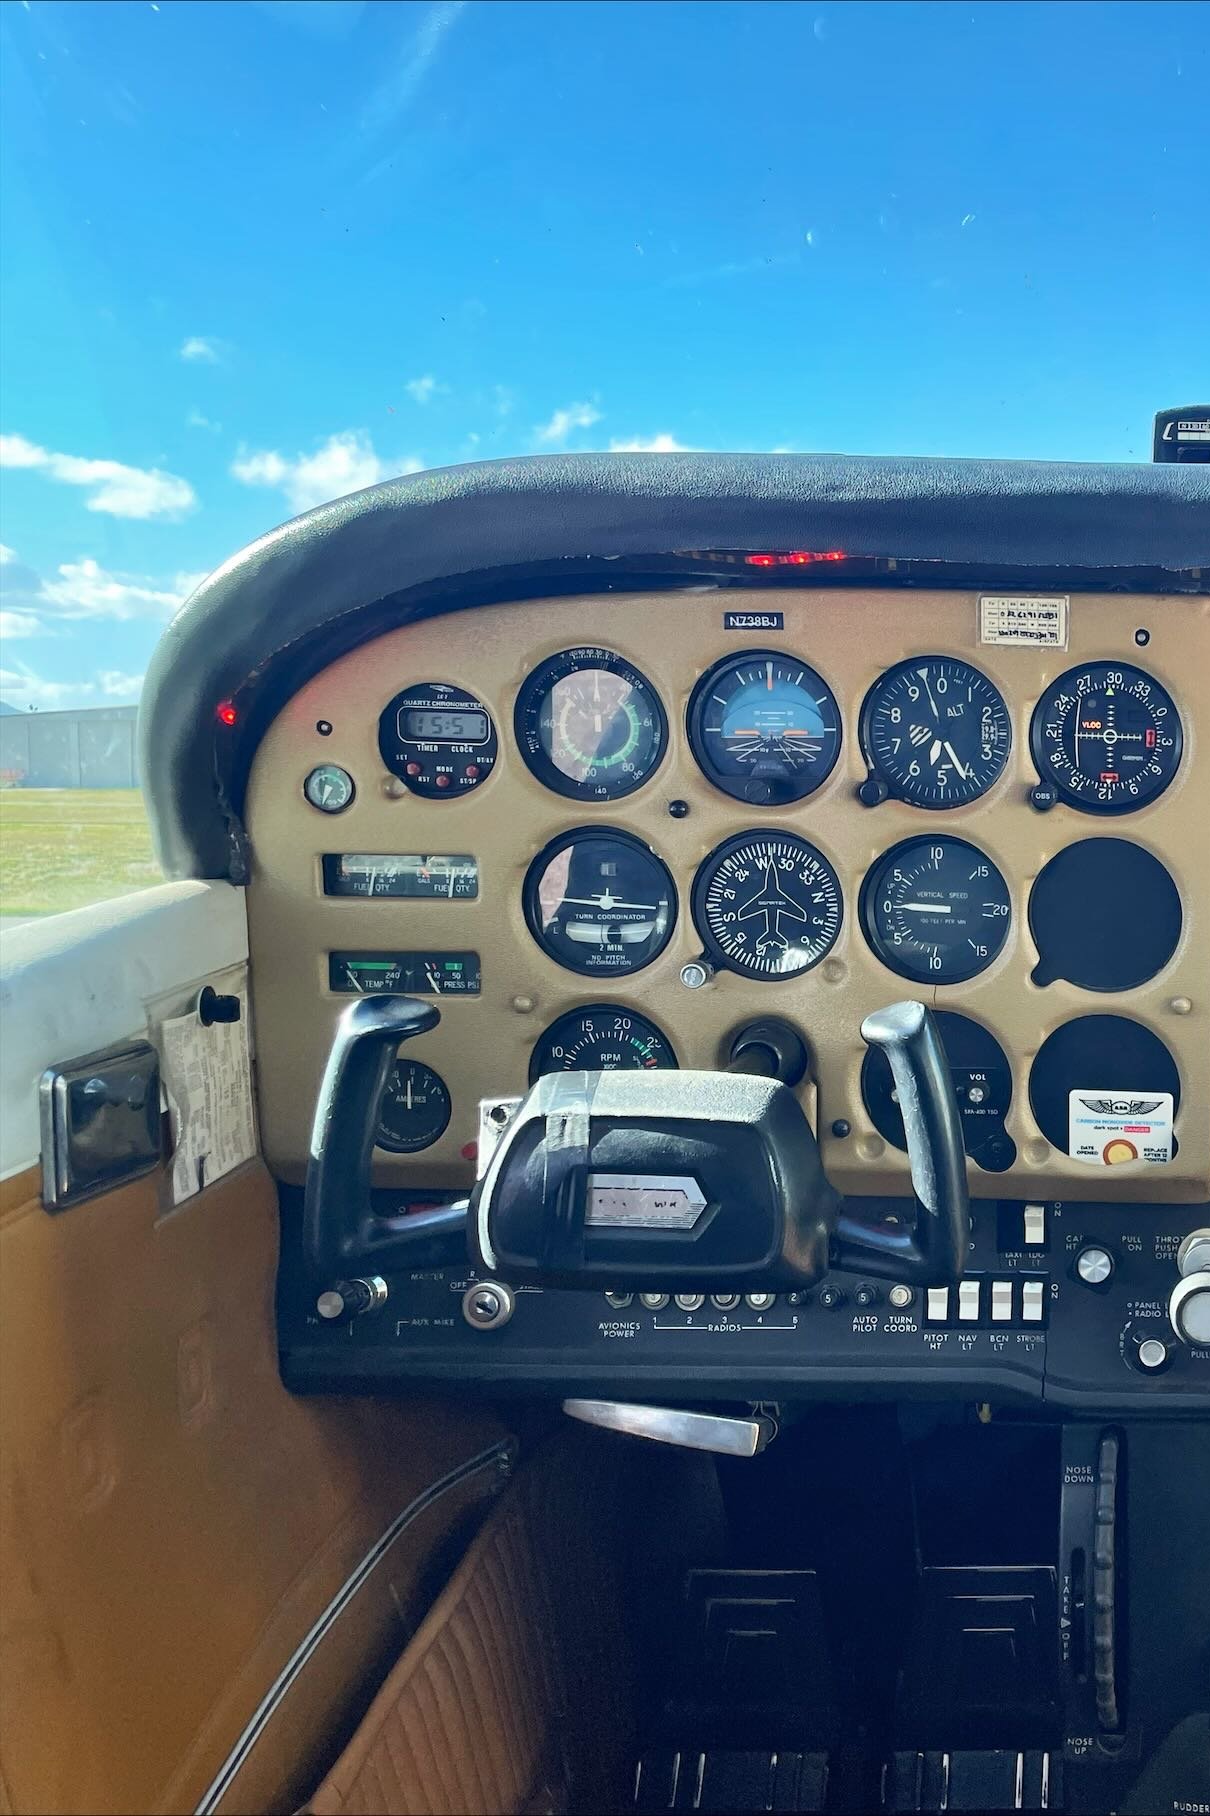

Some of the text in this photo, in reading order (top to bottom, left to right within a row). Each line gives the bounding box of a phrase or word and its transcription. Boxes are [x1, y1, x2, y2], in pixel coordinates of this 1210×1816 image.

[1077, 675, 1091, 691] 27
[1107, 672, 1122, 684] 30
[1134, 681, 1150, 696] 33
[1054, 694, 1069, 710] 24
[947, 704, 964, 717] ALT
[1046, 723, 1057, 738] 21
[1050, 753, 1062, 769] 18
[622, 763, 634, 772] 80
[1068, 776, 1084, 791] 15
[1098, 788, 1112, 800] 12
[931, 847, 943, 859] 10
[778, 859, 794, 871] 30
[735, 869, 749, 882] 24
[799, 870, 814, 885] 33
[978, 866, 988, 877] 15
[976, 946, 987, 956] 15
[930, 958, 941, 969] 10
[582, 1020, 593, 1032] 15
[614, 1018, 631, 1029] 20
[552, 1046, 563, 1057] 10
[1174, 1801, 1209, 1813] RUDDER
